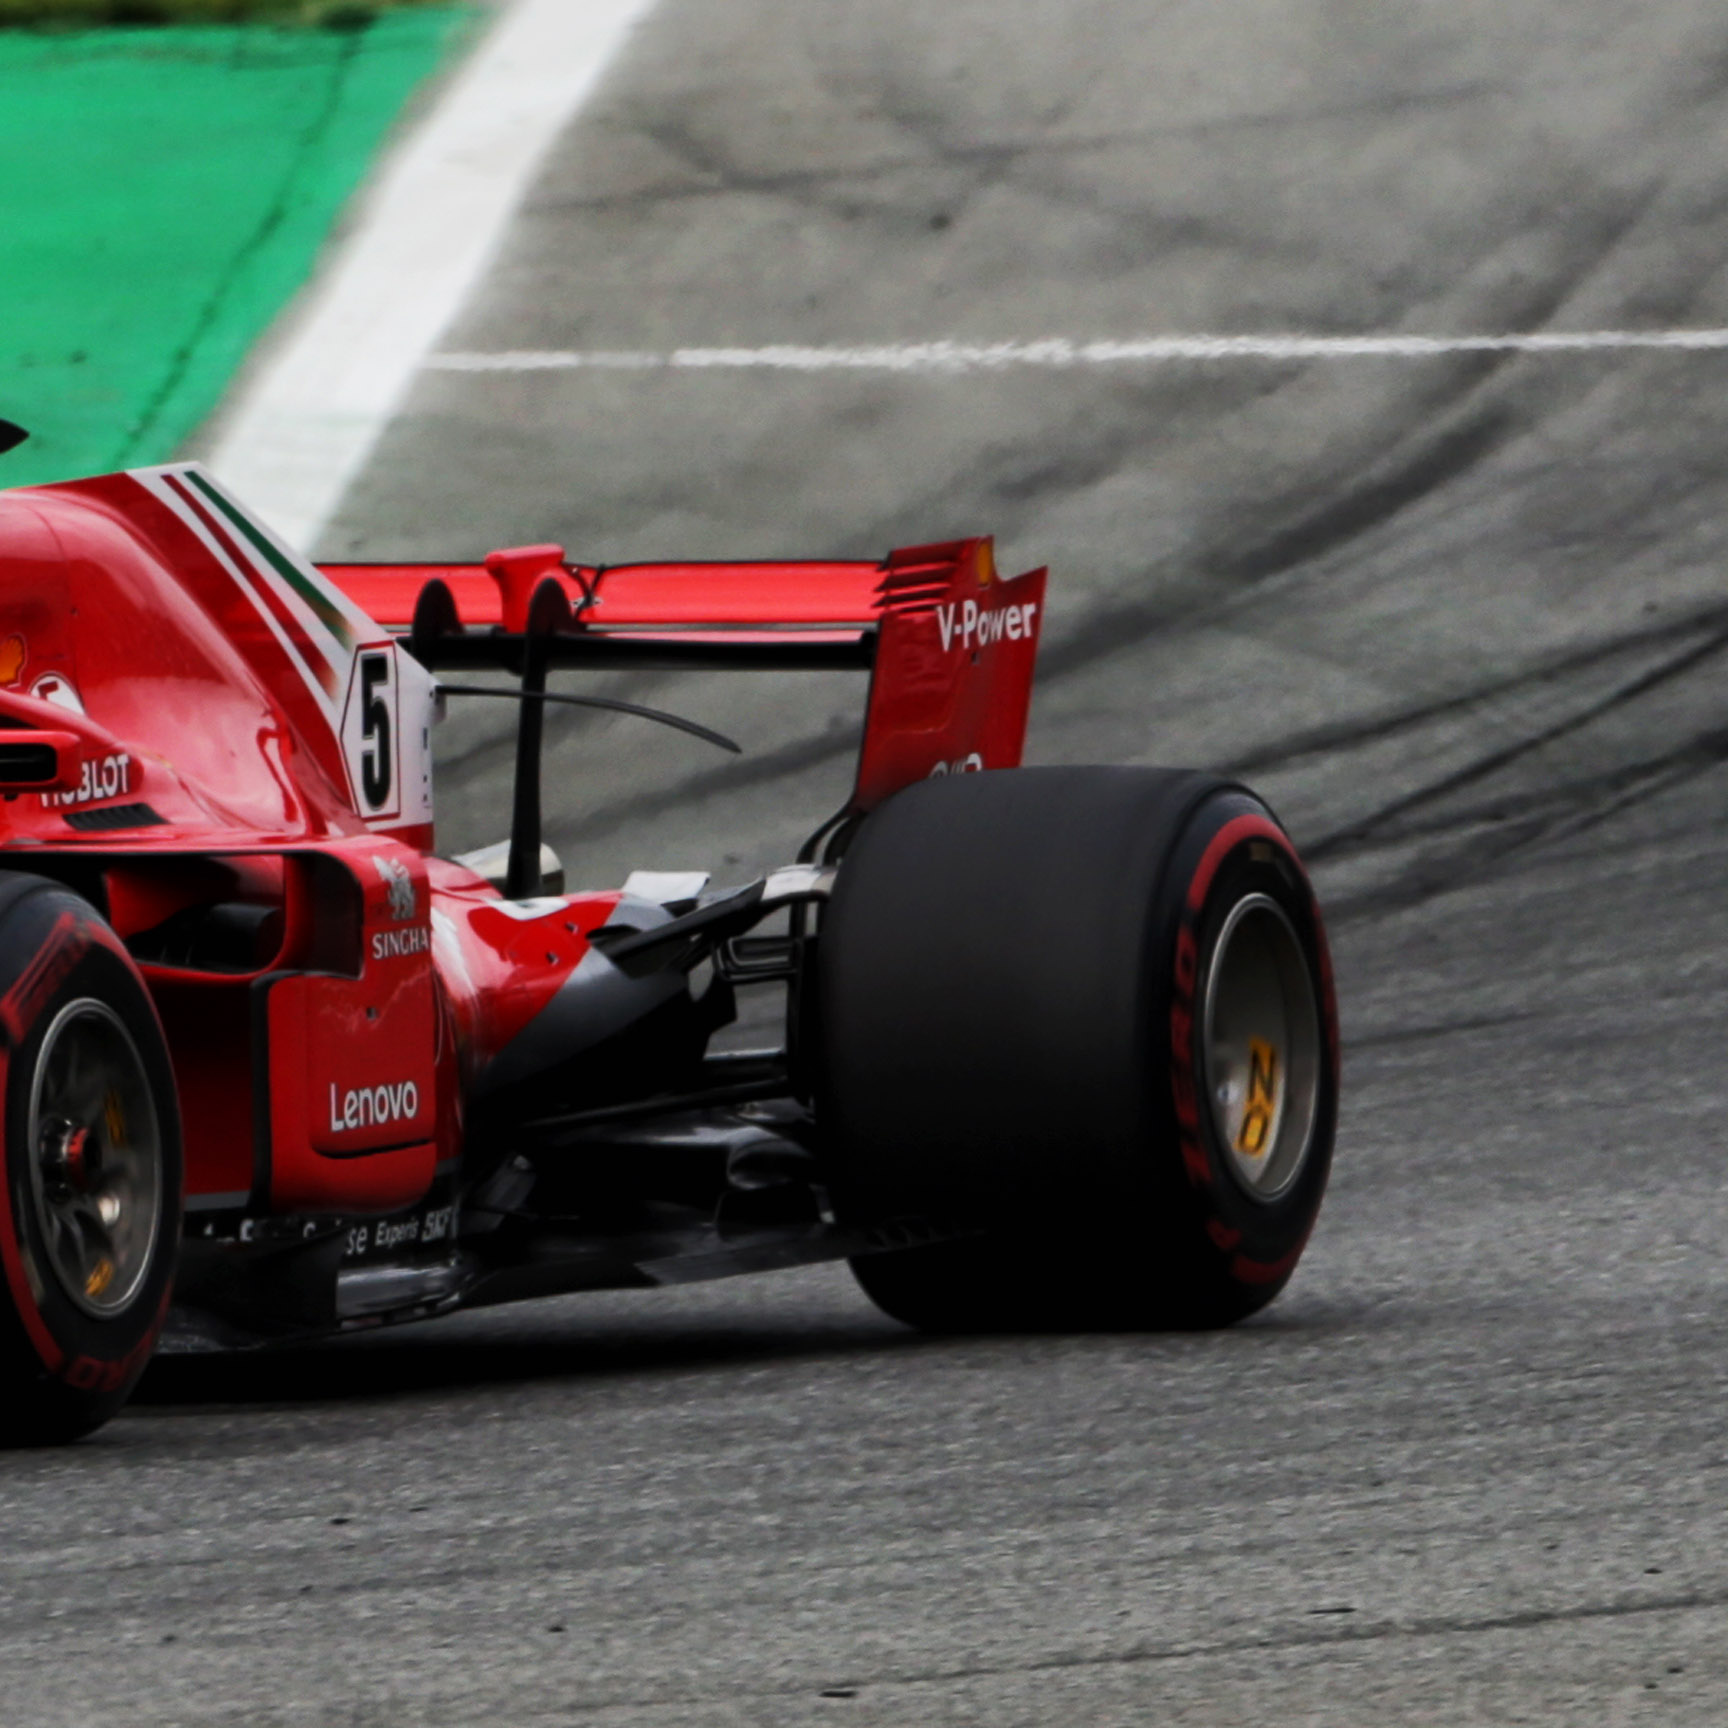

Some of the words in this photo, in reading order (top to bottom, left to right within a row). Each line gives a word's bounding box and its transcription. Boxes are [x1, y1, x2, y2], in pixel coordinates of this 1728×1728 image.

[936, 599, 1037, 653] V-Power
[361, 652, 391, 812] 5
[330, 1080, 417, 1132] Lenovo
